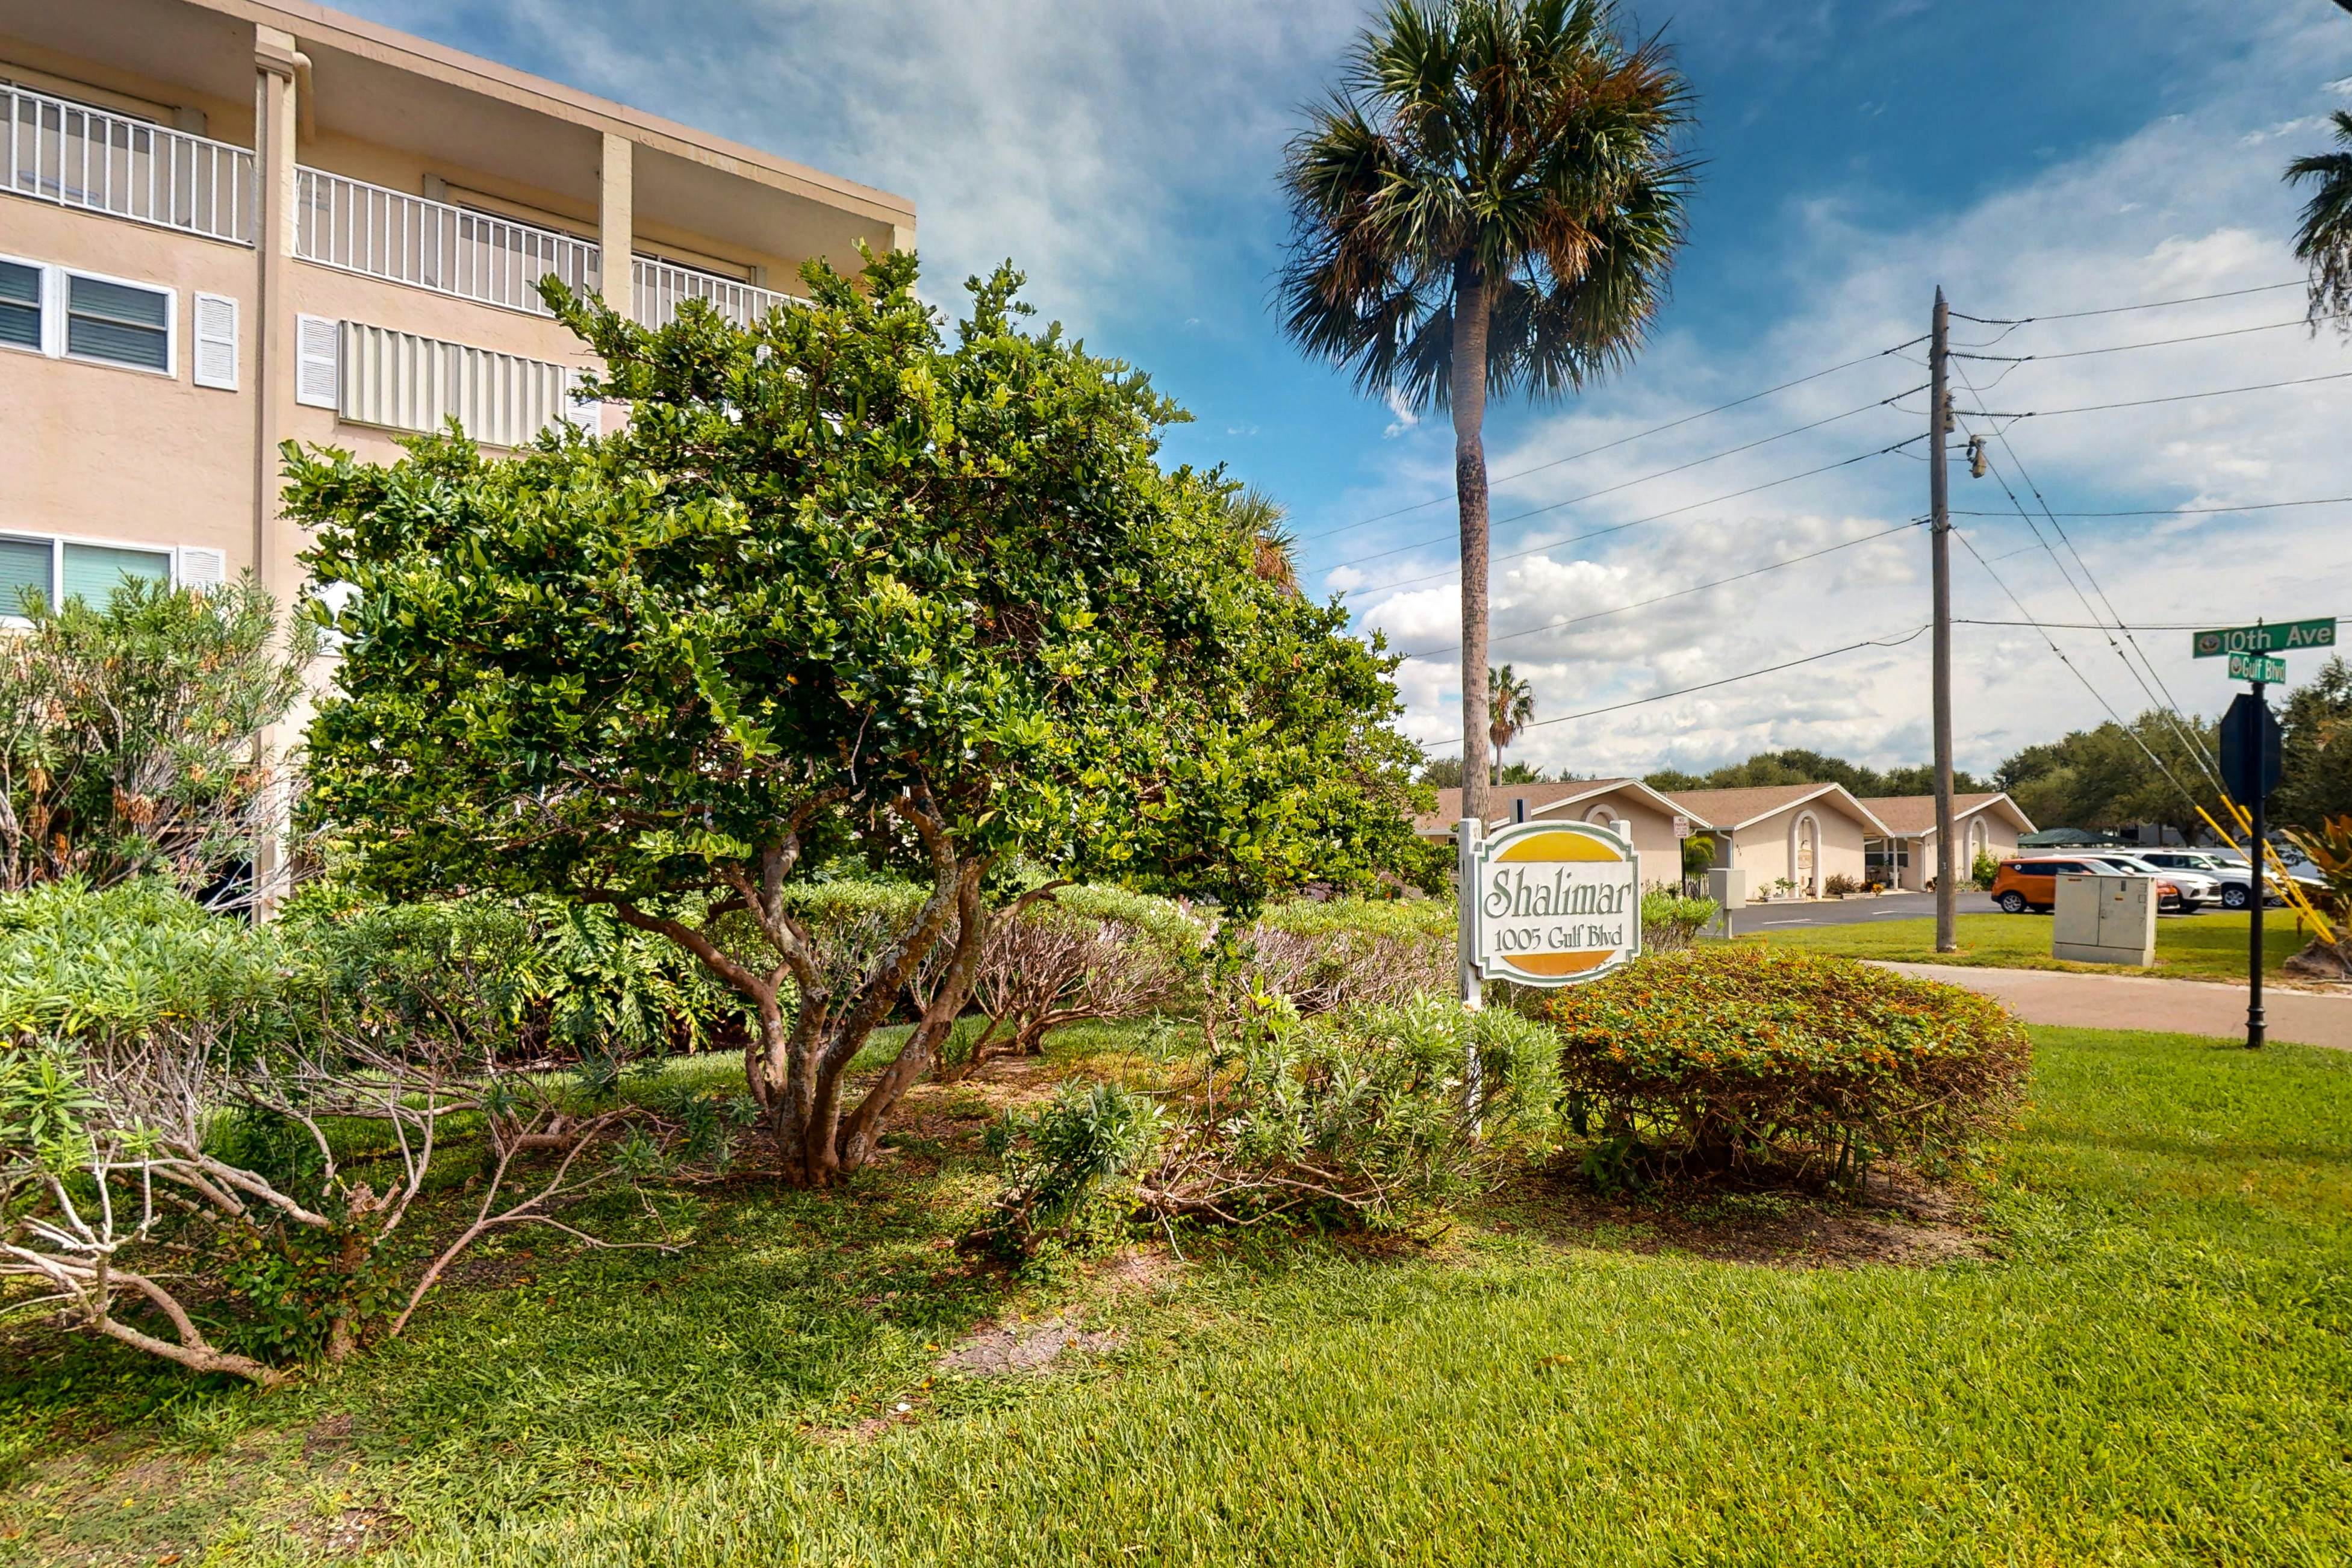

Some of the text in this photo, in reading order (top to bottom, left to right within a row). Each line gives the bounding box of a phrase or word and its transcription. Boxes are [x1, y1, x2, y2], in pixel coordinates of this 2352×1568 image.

[2223, 625, 2332, 652] 10th Ave
[2242, 656, 2285, 682] Gulf Blvd
[1483, 866, 1632, 918] Shalimar
[1495, 923, 1622, 951] 1005 Gulf Blvd
